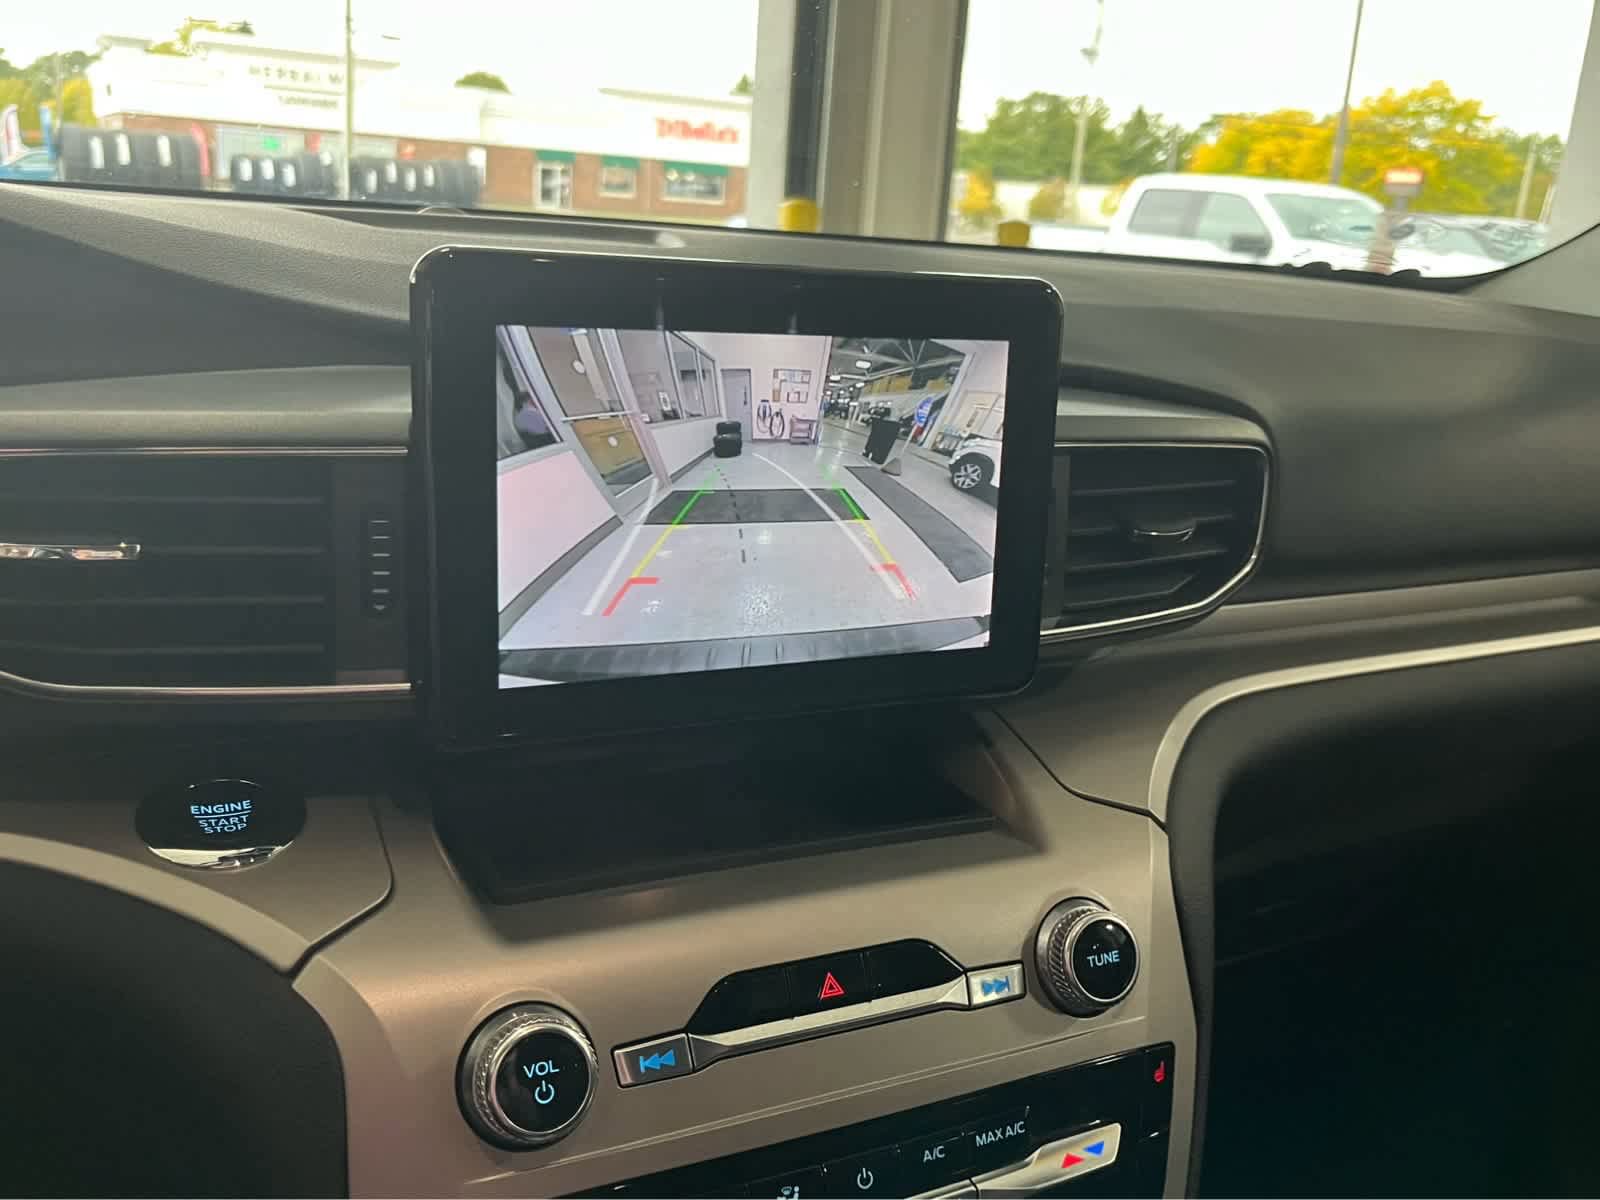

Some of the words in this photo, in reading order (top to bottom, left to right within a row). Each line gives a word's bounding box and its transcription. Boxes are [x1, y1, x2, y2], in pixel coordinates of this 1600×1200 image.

[190, 799, 252, 815] ENGINE
[198, 814, 249, 828] START
[203, 823, 247, 834] STOP
[1086, 950, 1121, 968] TUNE
[523, 1060, 560, 1078] VOL
[975, 1127, 1004, 1147] MAX
[1004, 1121, 1026, 1139] A/C
[923, 1145, 946, 1163] A/C
